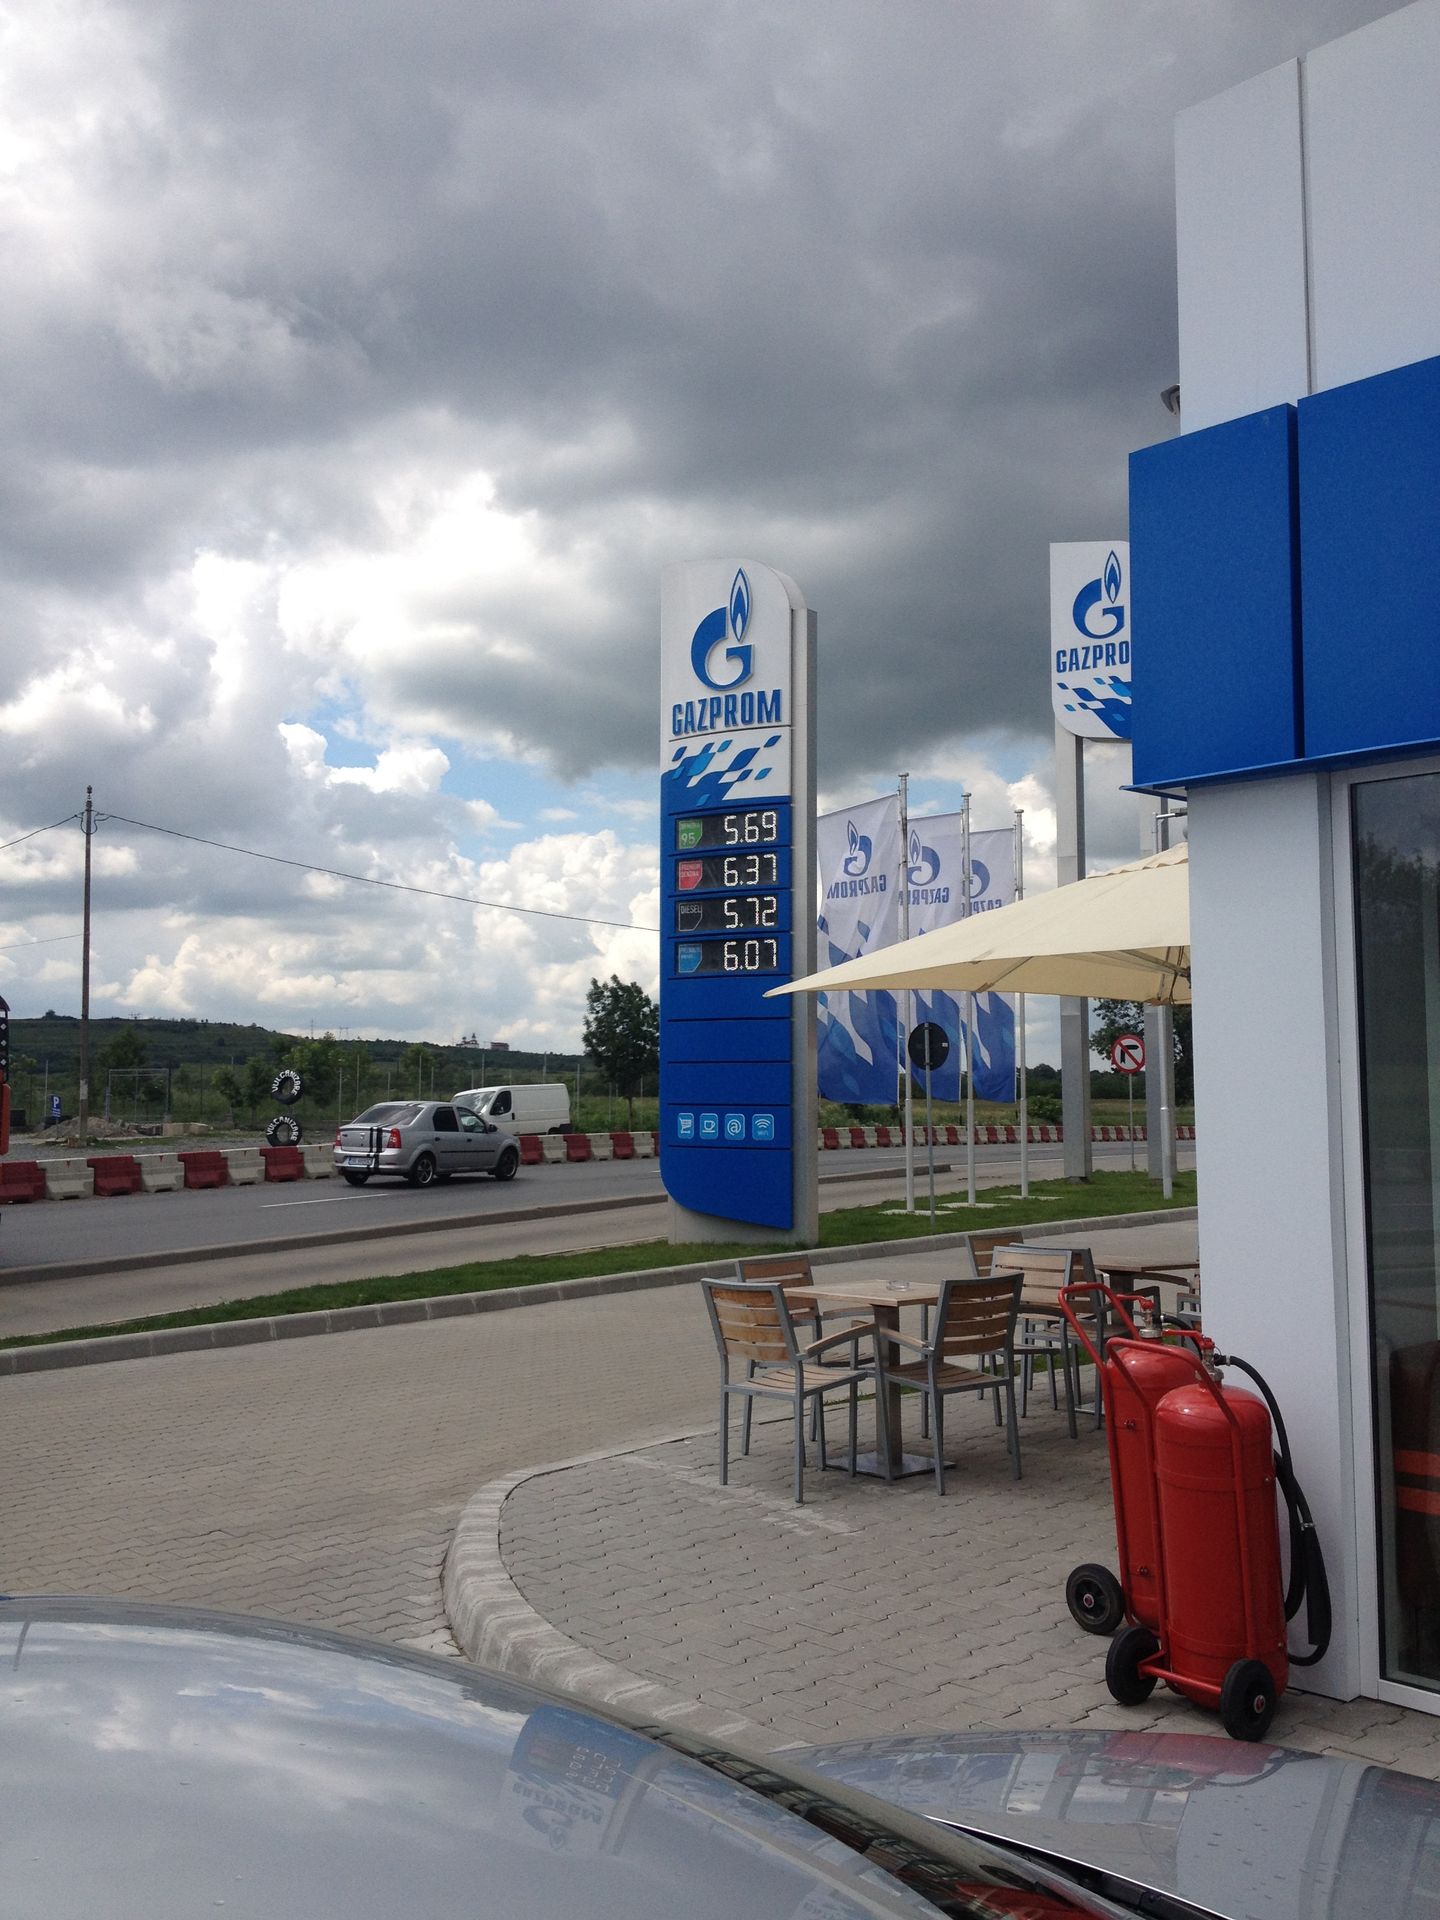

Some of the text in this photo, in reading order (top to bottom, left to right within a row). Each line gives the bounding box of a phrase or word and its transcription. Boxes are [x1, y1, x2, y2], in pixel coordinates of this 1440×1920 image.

[1056, 640, 1130, 674] GAZPRO
[672, 688, 782, 737] GAZPROM
[681, 832, 695, 845] 95
[724, 811, 777, 845] 5.69
[723, 854, 777, 887] 6.37
[681, 905, 702, 914] DIESEL
[724, 896, 777, 929] 5.72
[723, 939, 777, 971] 6.07
[271, 1069, 301, 1096] VULCANIZARE
[53, 1096, 60, 1108] P
[266, 1116, 299, 1142] VULCANIZARE
